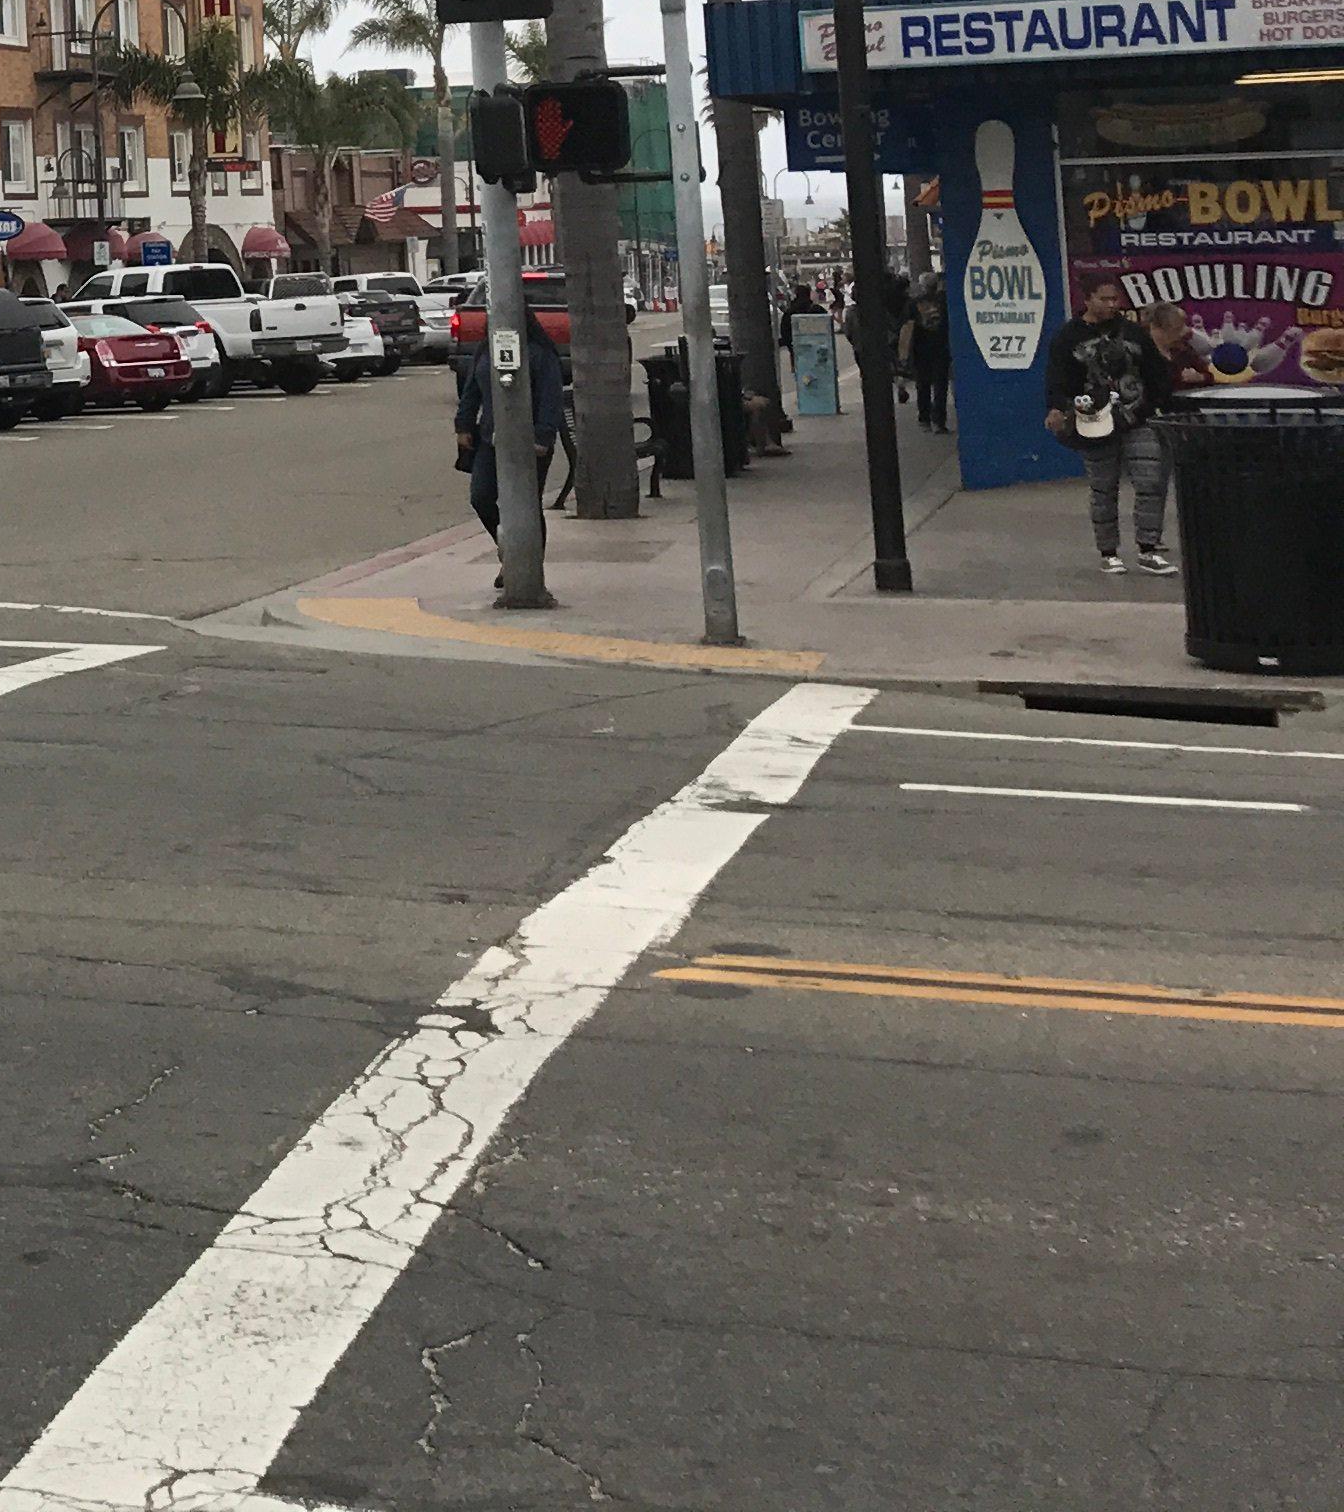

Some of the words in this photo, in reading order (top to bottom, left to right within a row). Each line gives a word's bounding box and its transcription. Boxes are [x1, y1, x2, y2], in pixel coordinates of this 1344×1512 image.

[1263, 9, 1344, 25] BURGERS
[1259, 28, 1294, 41] HOT
[1303, 25, 1344, 40] DOG
[1187, 178, 1344, 225] BOWL
[1120, 230, 1316, 247] RESTAURANT
[969, 265, 1043, 301] BOWL
[1121, 263, 1333, 308] BOWLING
[975, 311, 1036, 324] RESTAURANT
[989, 336, 1026, 352] 277
